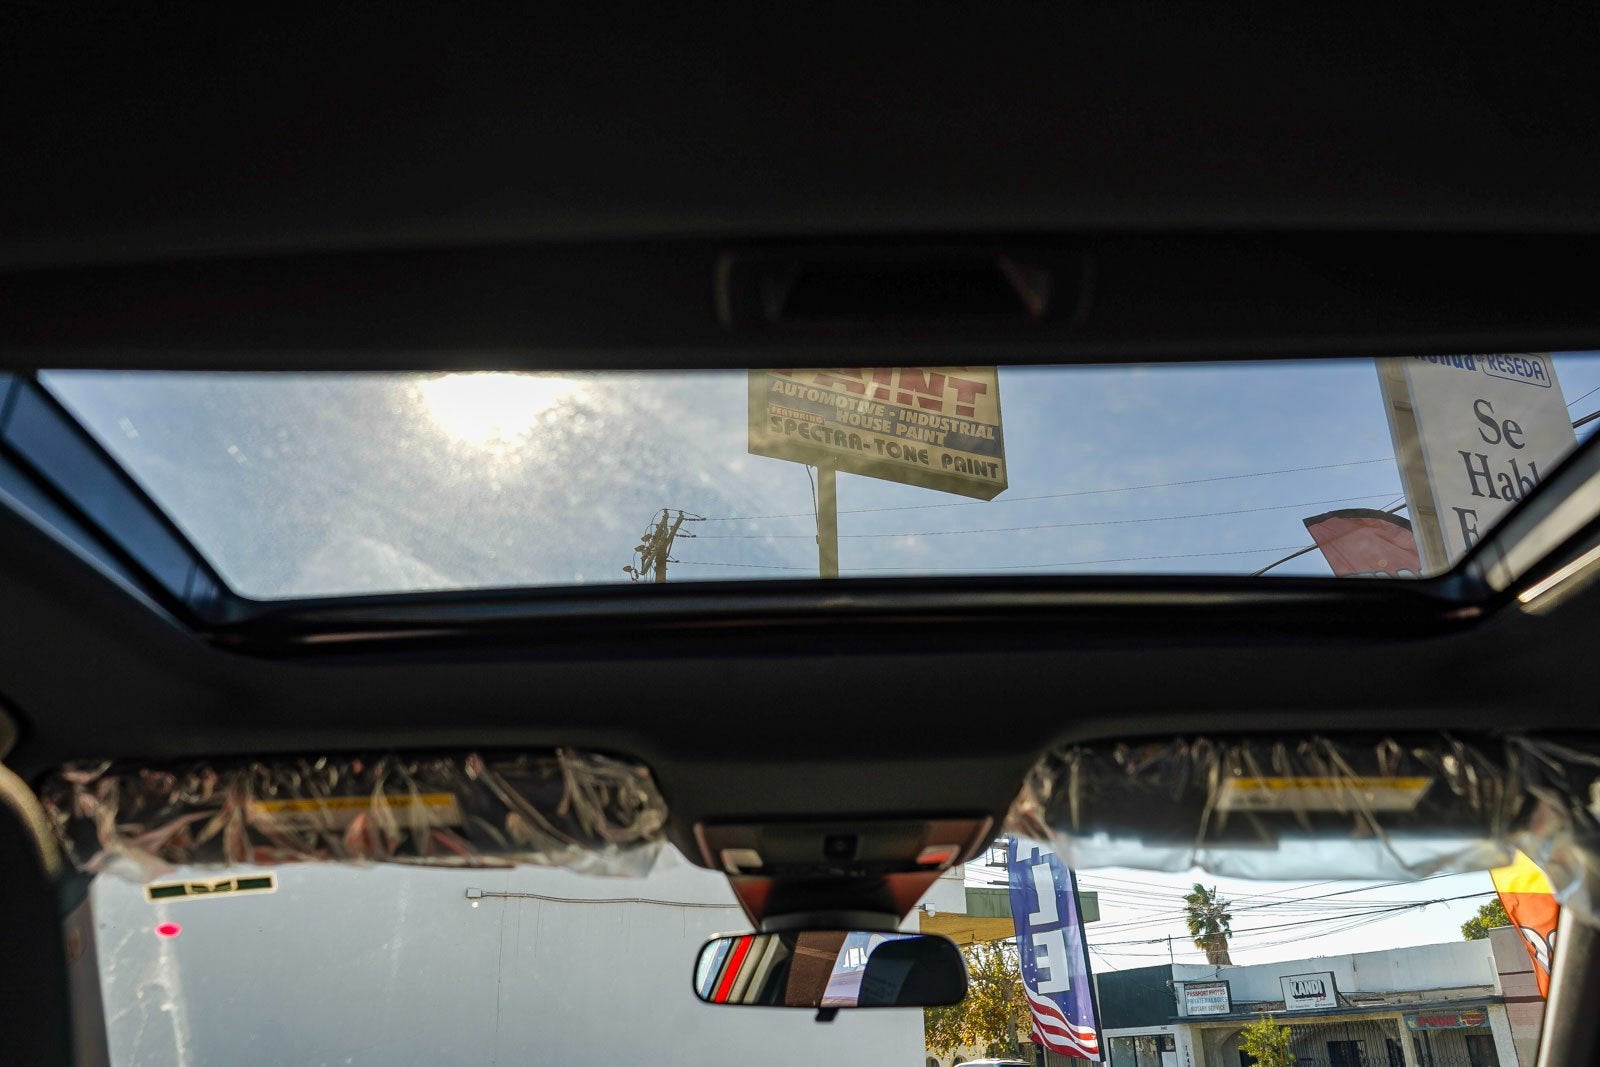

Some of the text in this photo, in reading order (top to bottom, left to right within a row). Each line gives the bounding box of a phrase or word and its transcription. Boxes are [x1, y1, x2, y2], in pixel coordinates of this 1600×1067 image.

[1487, 354, 1545, 381] RESEDA
[771, 380, 885, 416] AUTOMOTIVE
[899, 409, 995, 440] INDUSTRIAL
[773, 367, 988, 418] AINT
[836, 410, 947, 446] HOUSE PAINT
[1473, 398, 1525, 449] Se
[941, 453, 999, 479] PAINT
[1289, 979, 1326, 999] KANDI
